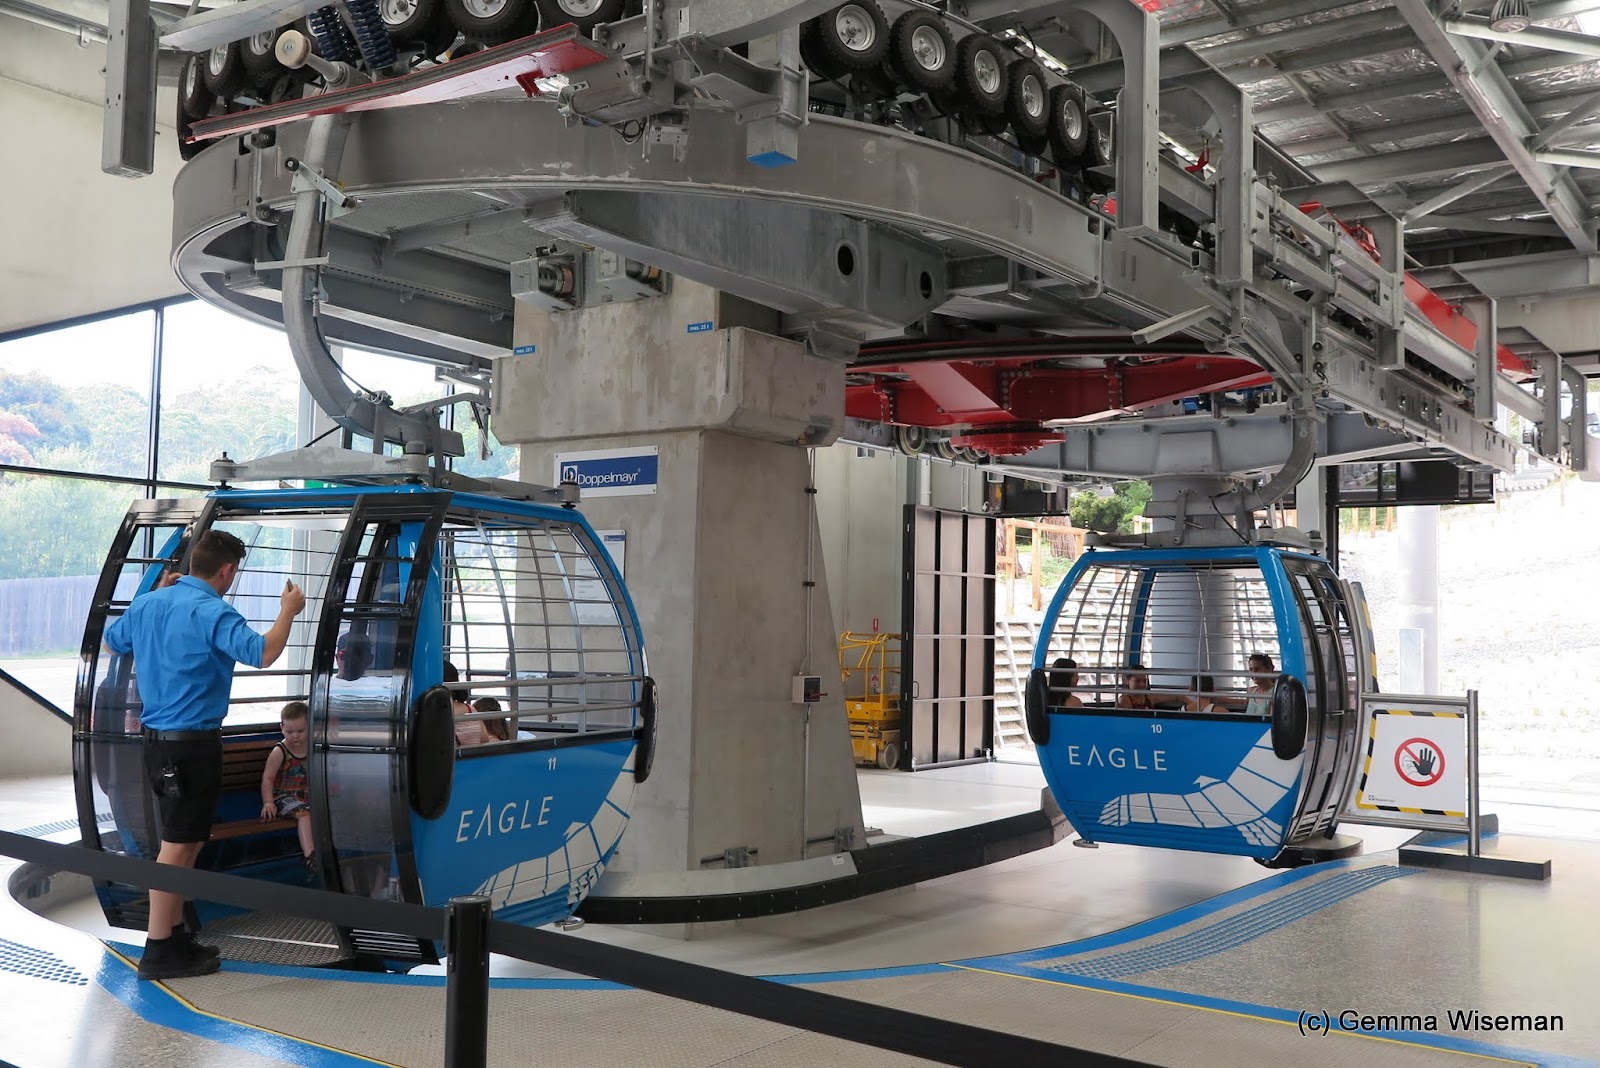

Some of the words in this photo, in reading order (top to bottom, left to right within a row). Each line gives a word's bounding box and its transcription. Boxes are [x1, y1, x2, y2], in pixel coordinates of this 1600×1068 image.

[577, 471, 639, 487] Doppelmayr
[1150, 723, 1163, 734] 10
[547, 757, 557, 771] 11
[1068, 744, 1168, 771] EAGLE
[456, 795, 554, 843] EAGLE
